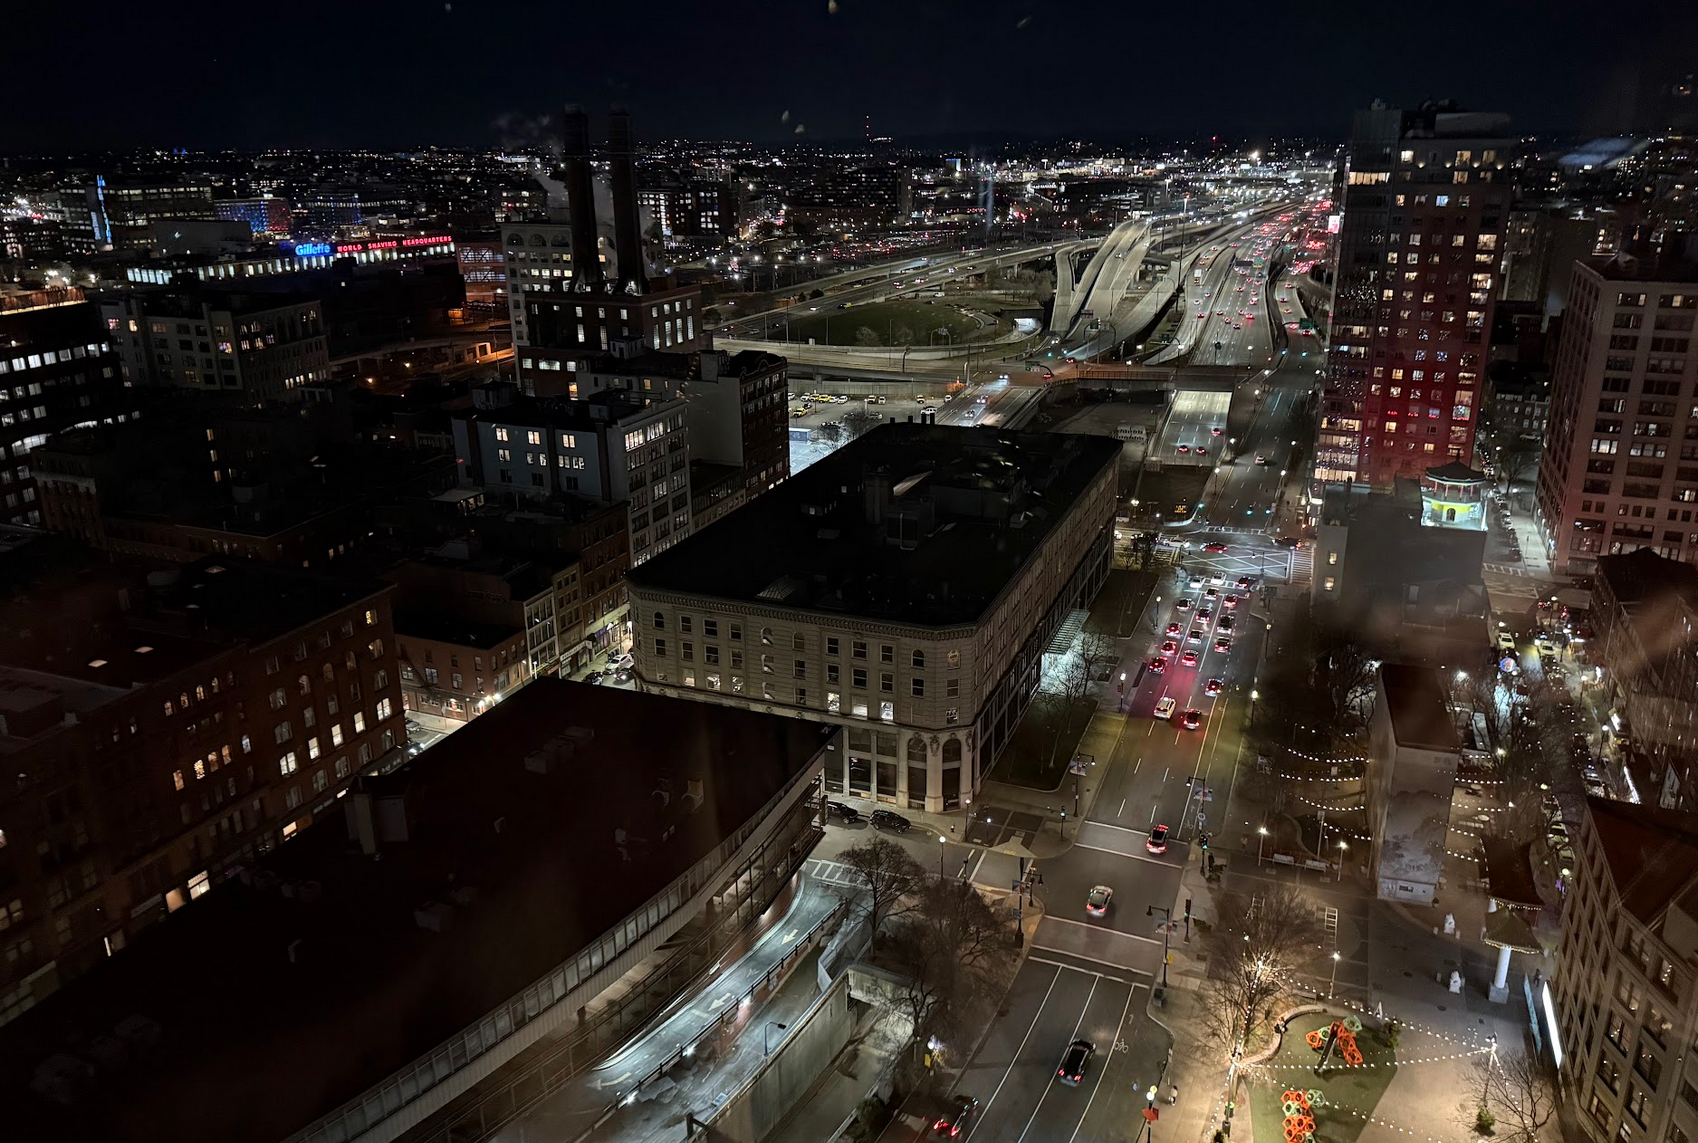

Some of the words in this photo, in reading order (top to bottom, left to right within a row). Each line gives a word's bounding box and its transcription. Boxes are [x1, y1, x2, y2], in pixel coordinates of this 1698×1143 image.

[295, 242, 331, 256] Gillette
[337, 244, 363, 253] WORLD
[367, 240, 397, 250] SHAVING
[402, 235, 452, 246] HEADQUARTERS
